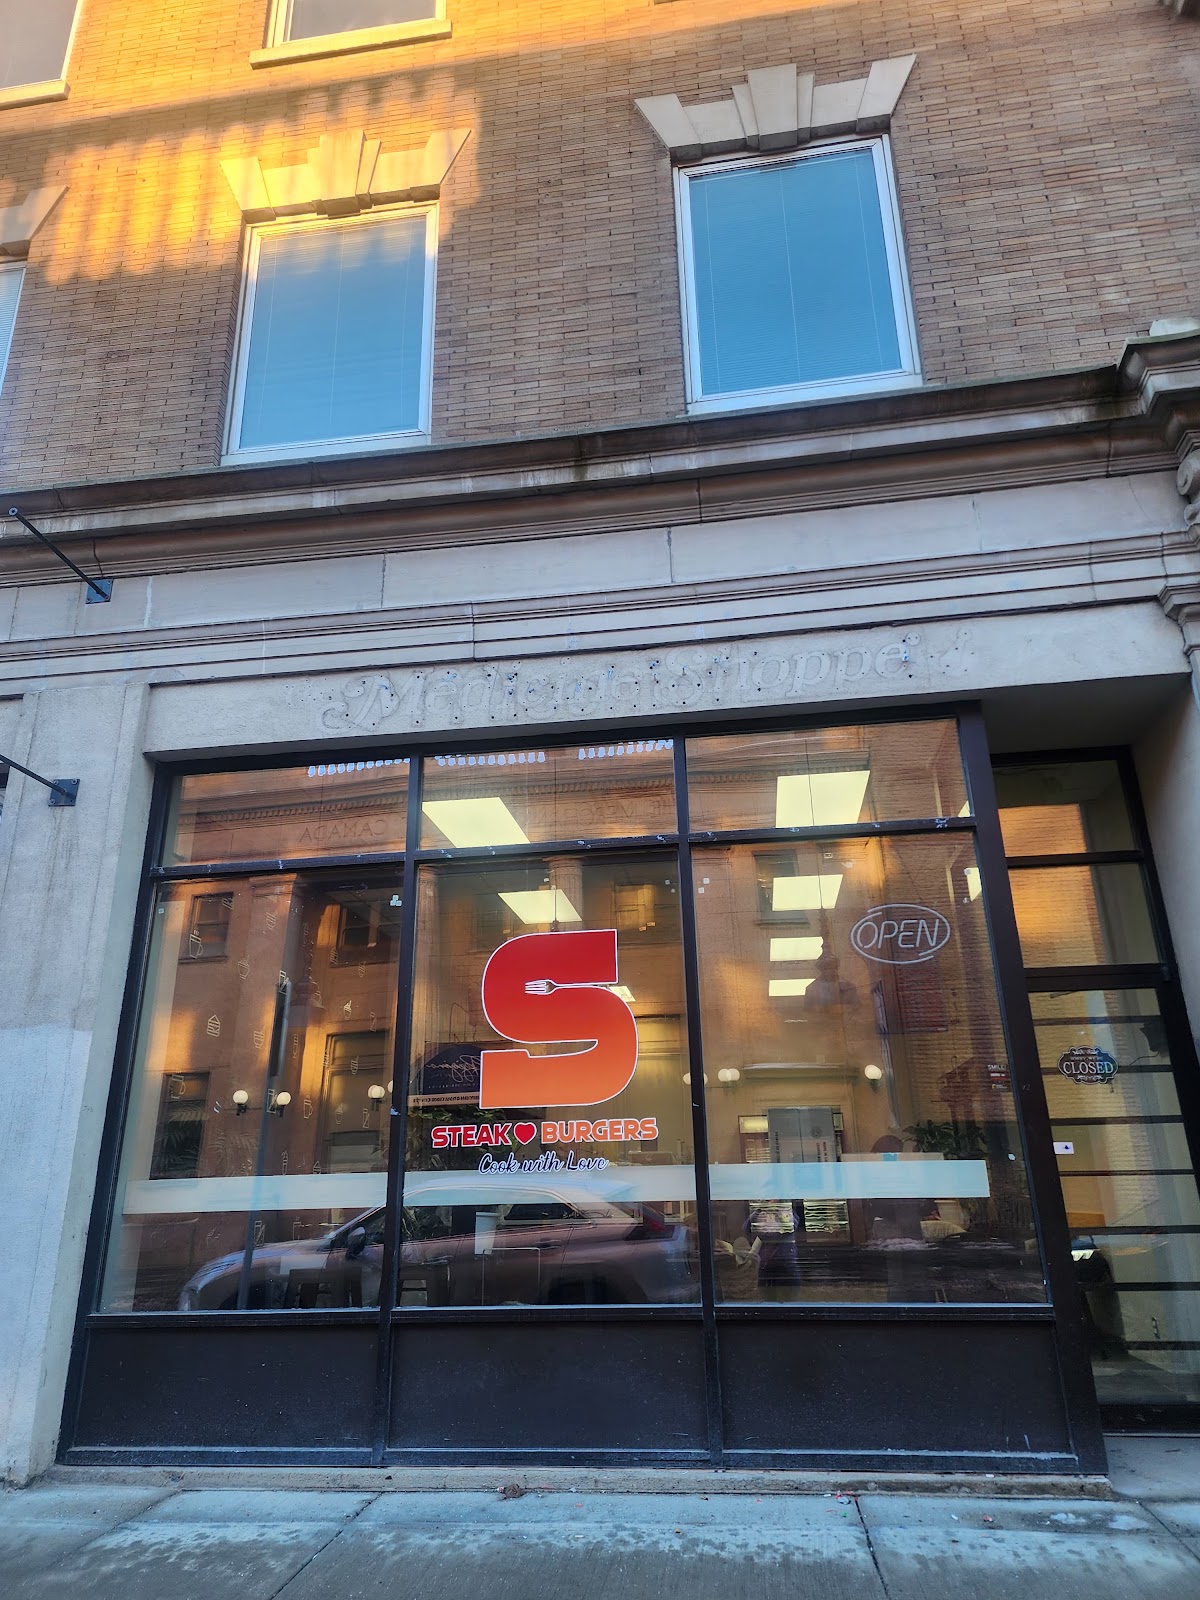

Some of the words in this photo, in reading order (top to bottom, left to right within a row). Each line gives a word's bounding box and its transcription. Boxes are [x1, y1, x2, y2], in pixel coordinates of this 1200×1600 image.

[856, 919, 939, 949] OPEN
[1063, 1061, 1114, 1074] CLOSED
[432, 1123, 512, 1148] STEAK
[541, 1117, 659, 1144] BURGERS
[479, 1152, 521, 1174] Cook
[522, 1151, 565, 1173] with
[566, 1151, 610, 1172] Love
